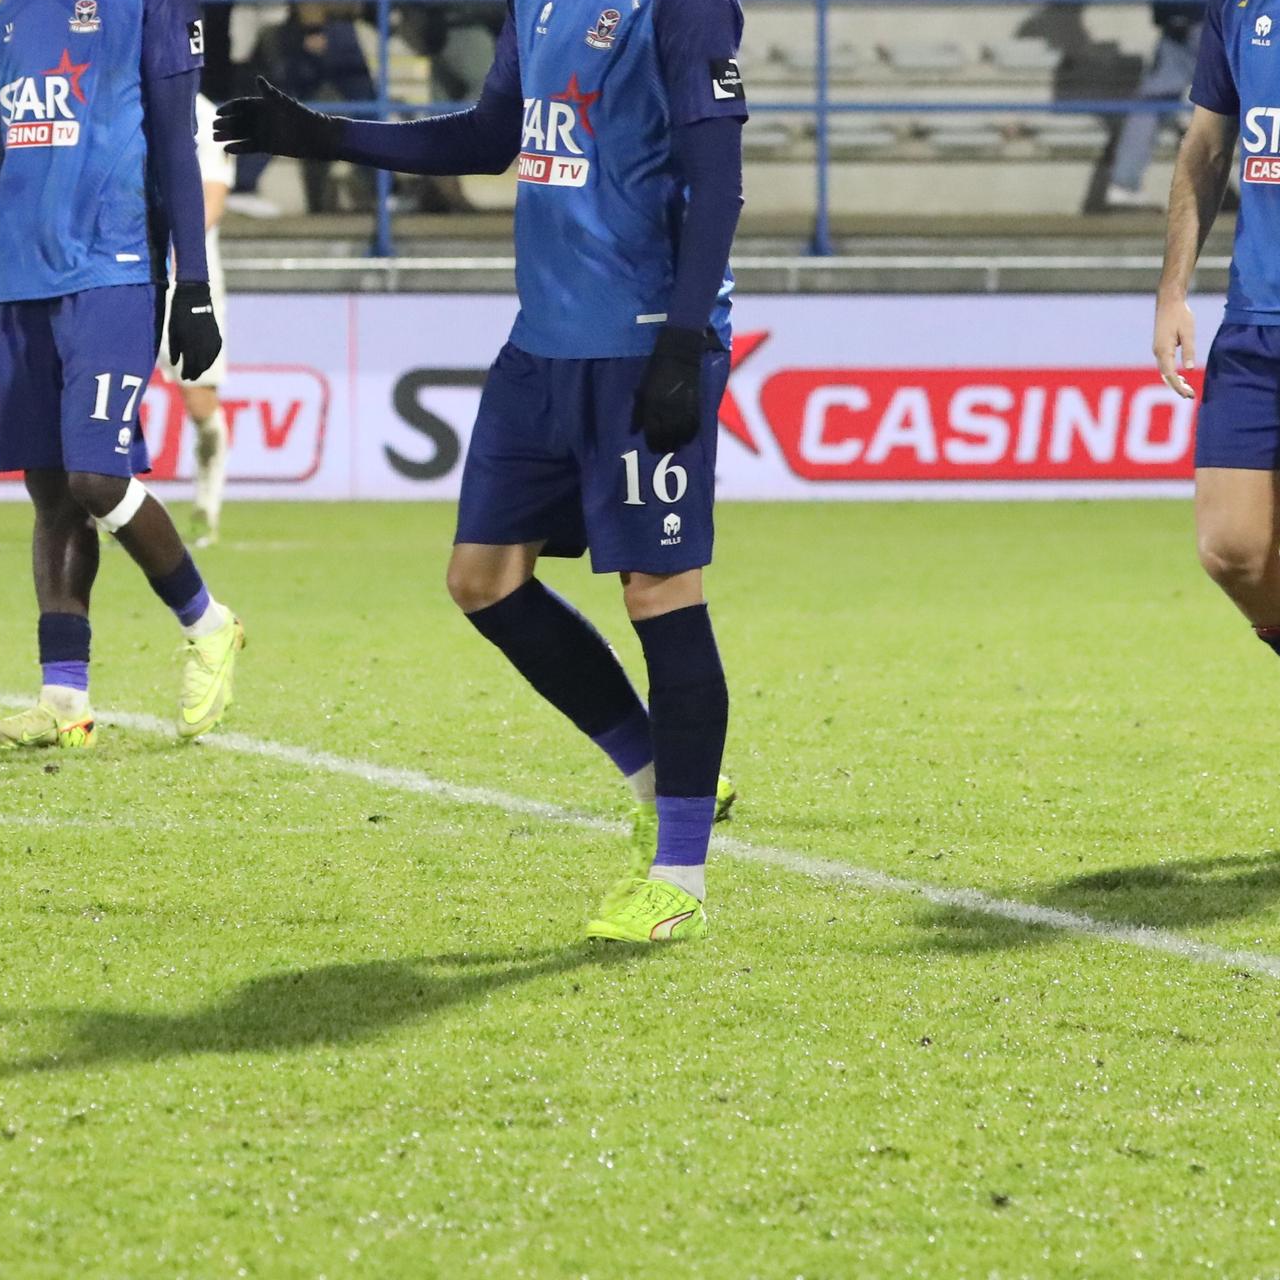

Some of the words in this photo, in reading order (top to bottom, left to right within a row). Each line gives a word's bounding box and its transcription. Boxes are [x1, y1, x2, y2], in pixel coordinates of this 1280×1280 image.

[6, 125, 50, 145] SINO
[56, 126, 75, 140] TV
[558, 163, 583, 180] TV
[89, 373, 144, 422] 17
[799, 384, 1195, 465] CASINO
[620, 449, 688, 506] 16
